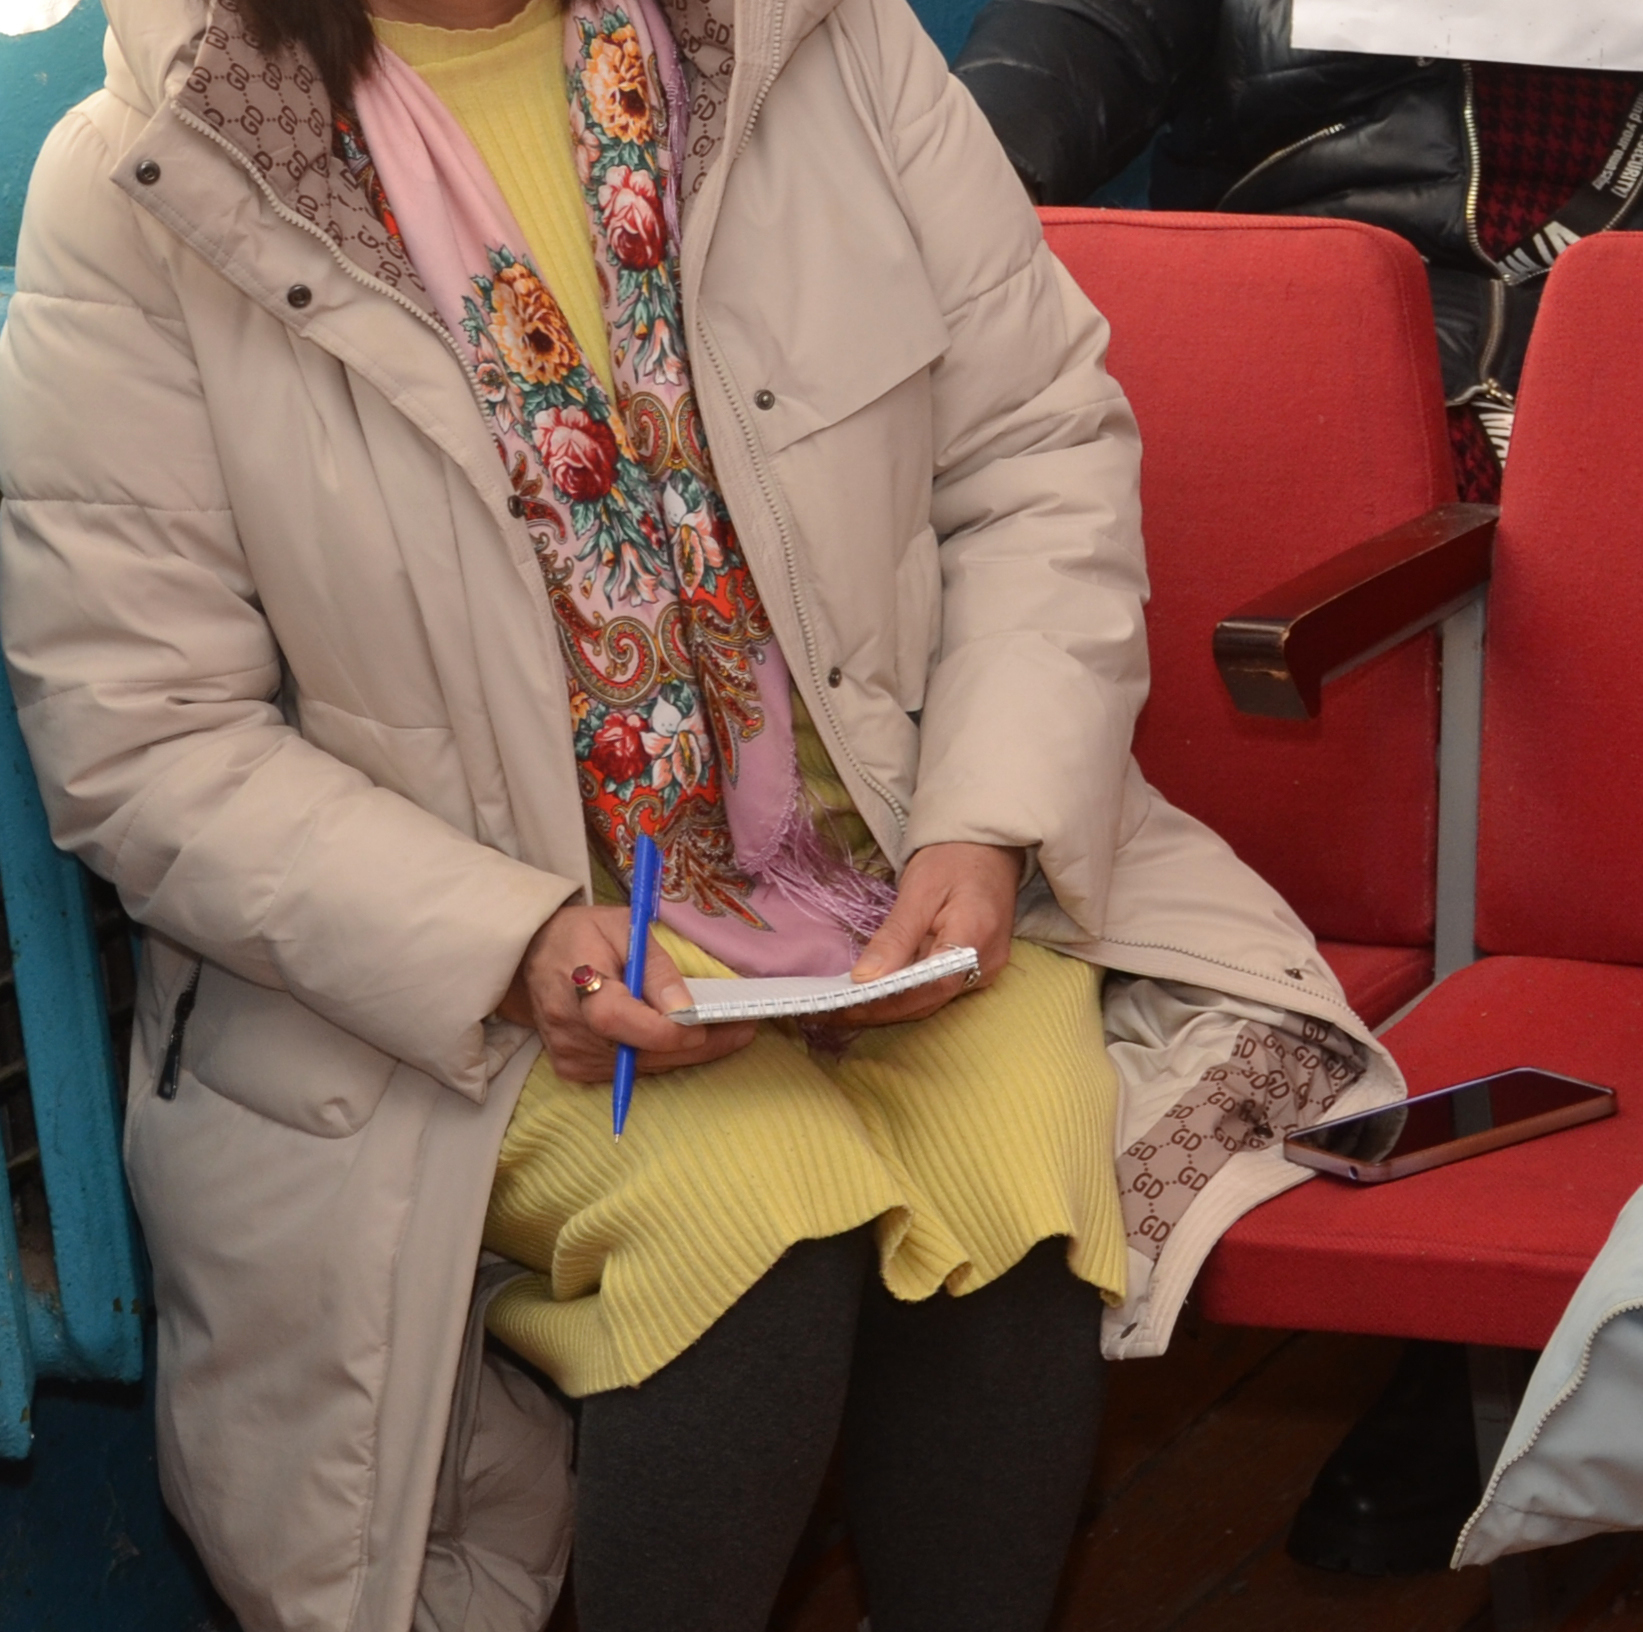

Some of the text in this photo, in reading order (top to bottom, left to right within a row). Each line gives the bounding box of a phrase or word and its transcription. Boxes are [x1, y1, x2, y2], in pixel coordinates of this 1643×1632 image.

[1171, 1128, 1202, 1151] GD
[1133, 1172, 1163, 1199] GD
[1139, 1215, 1170, 1243] GD
